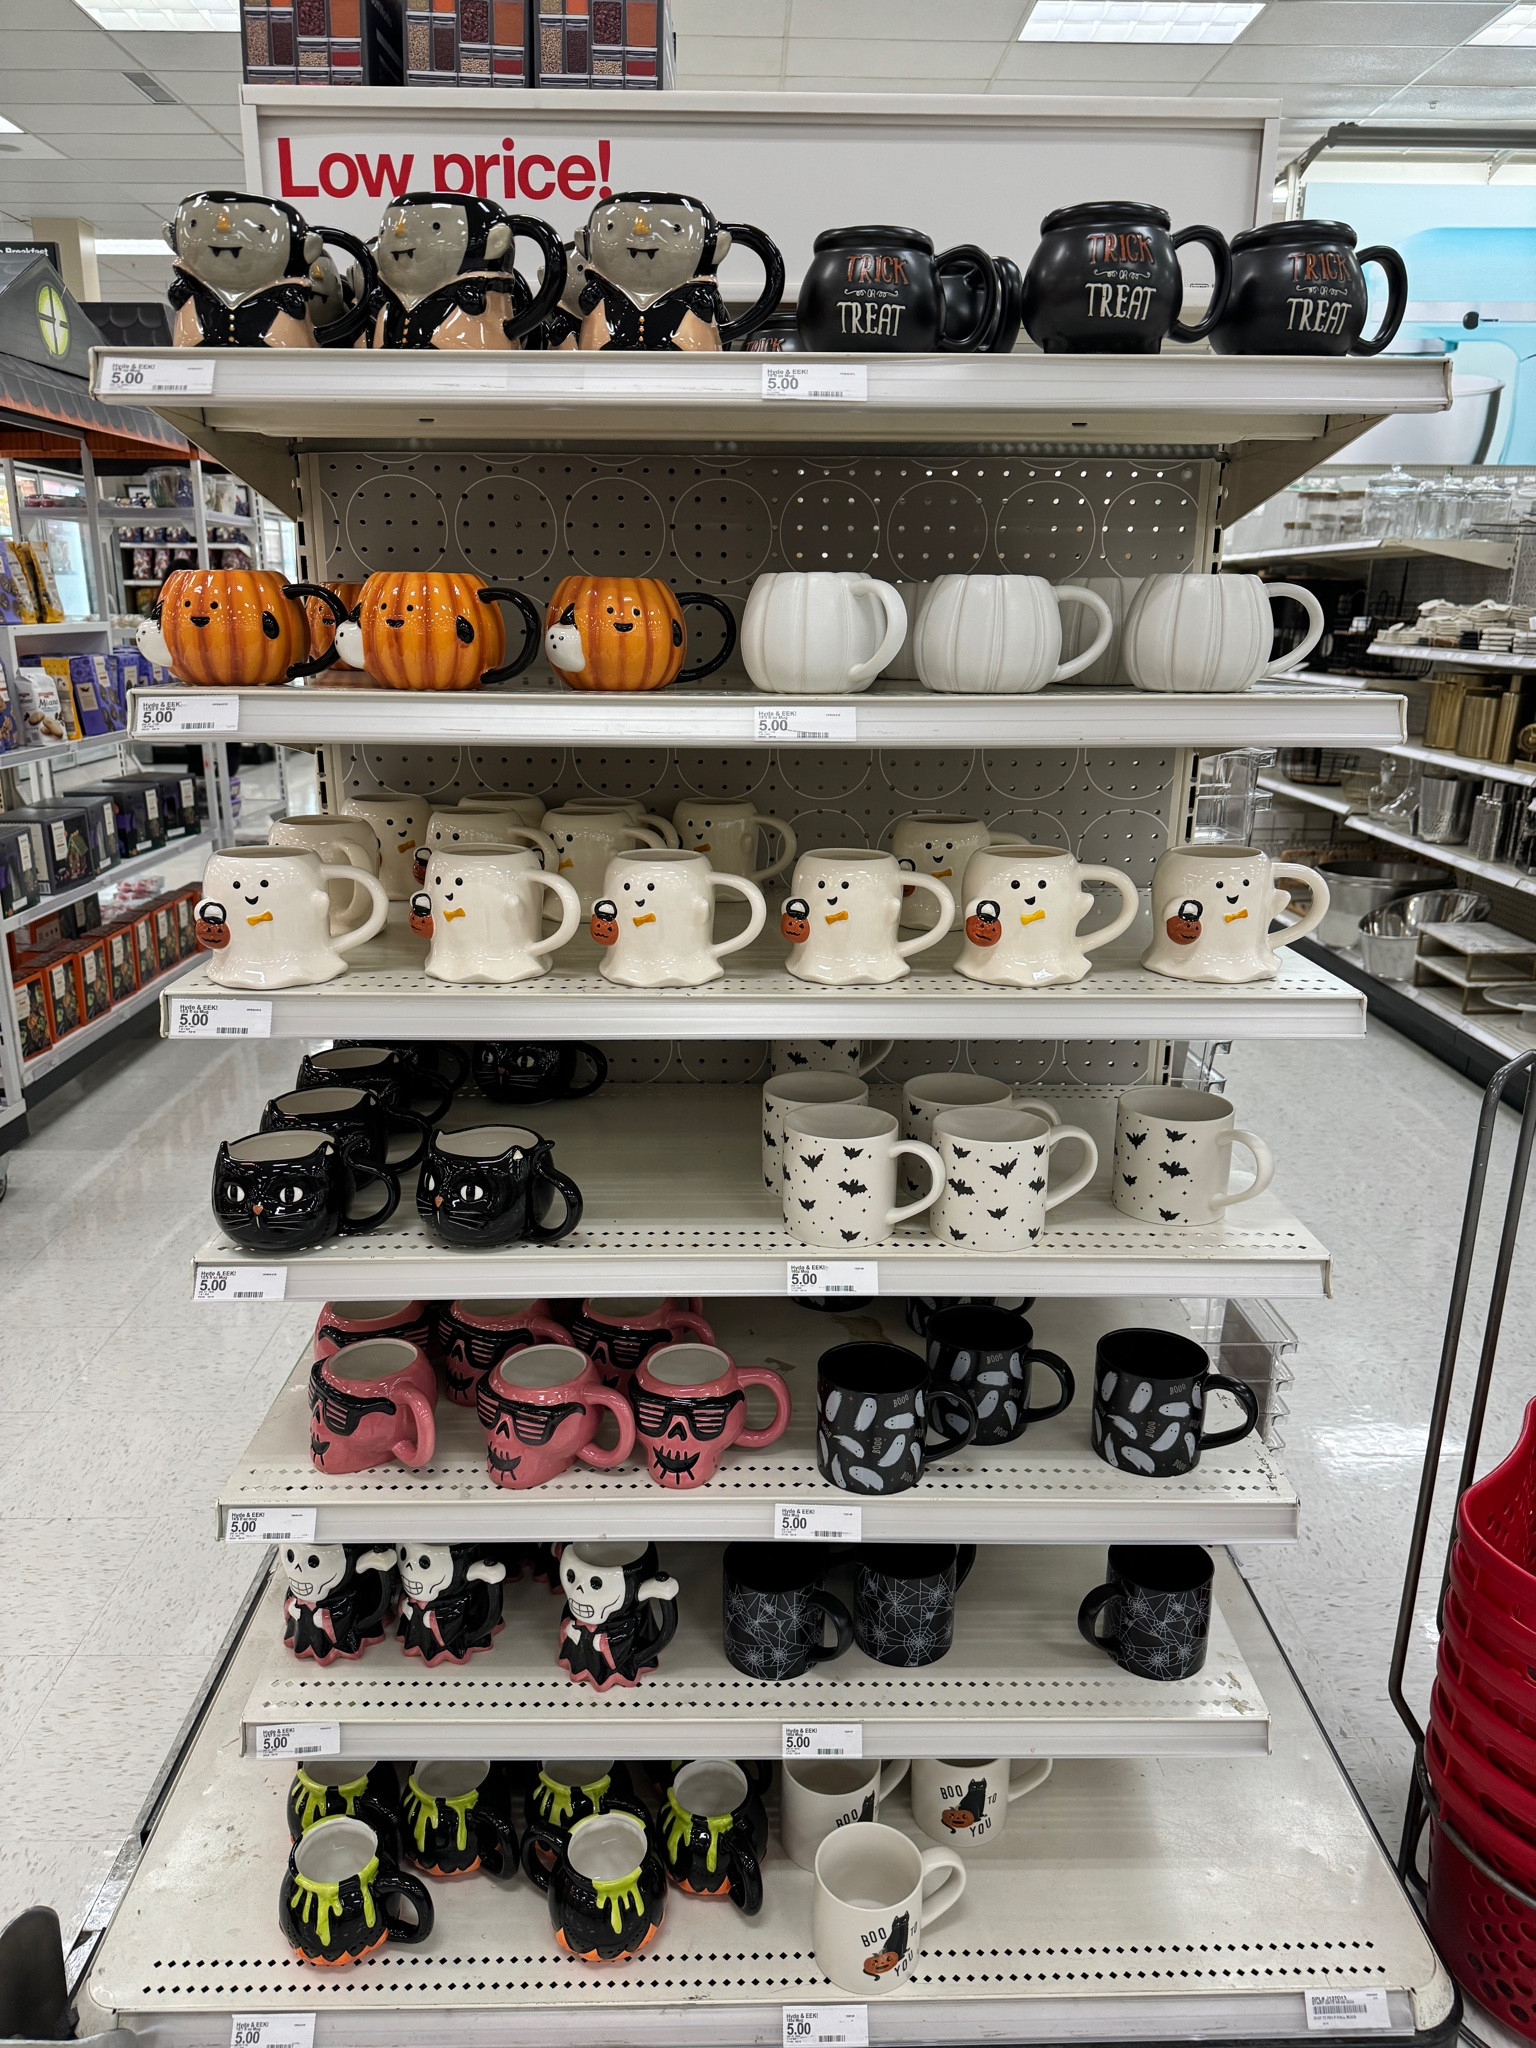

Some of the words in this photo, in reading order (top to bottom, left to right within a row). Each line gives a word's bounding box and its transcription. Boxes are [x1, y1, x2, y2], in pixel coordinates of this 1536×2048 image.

[277, 137, 415, 198] Low
[433, 137, 613, 201] price!
[1086, 232, 1155, 265] TRICK
[846, 254, 909, 285] TRICK
[1288, 252, 1352, 282] TRICK
[1118, 269, 1128, 280] OR
[866, 290, 877, 299] OR
[1319, 285, 1329, 296] OR
[1085, 282, 1157, 321] TREAT
[836, 301, 906, 337] TREAT
[1286, 297, 1353, 336] TREAT
[111, 372, 144, 384] 5.00
[767, 378, 798, 389] 5.00
[143, 711, 172, 723] 5.00
[759, 720, 788, 731] 5.00
[179, 1014, 208, 1026] 5.00
[200, 1279, 227, 1291] 5.00
[791, 1273, 817, 1285] 5.00
[231, 1521, 256, 1532] 5.00
[782, 1517, 807, 1529] 5.00
[263, 1736, 288, 1749] 5.00
[786, 1736, 810, 1748] 5.00
[940, 1784, 963, 1800] BOO
[987, 1792, 998, 1805] TO
[835, 1808, 859, 1828] BOO
[969, 1817, 992, 1838] YOU
[860, 1927, 887, 1948] BOO
[894, 1949, 914, 1977] YOU
[786, 2022, 811, 2035] 5.00
[235, 2031, 260, 2044] 5.00
